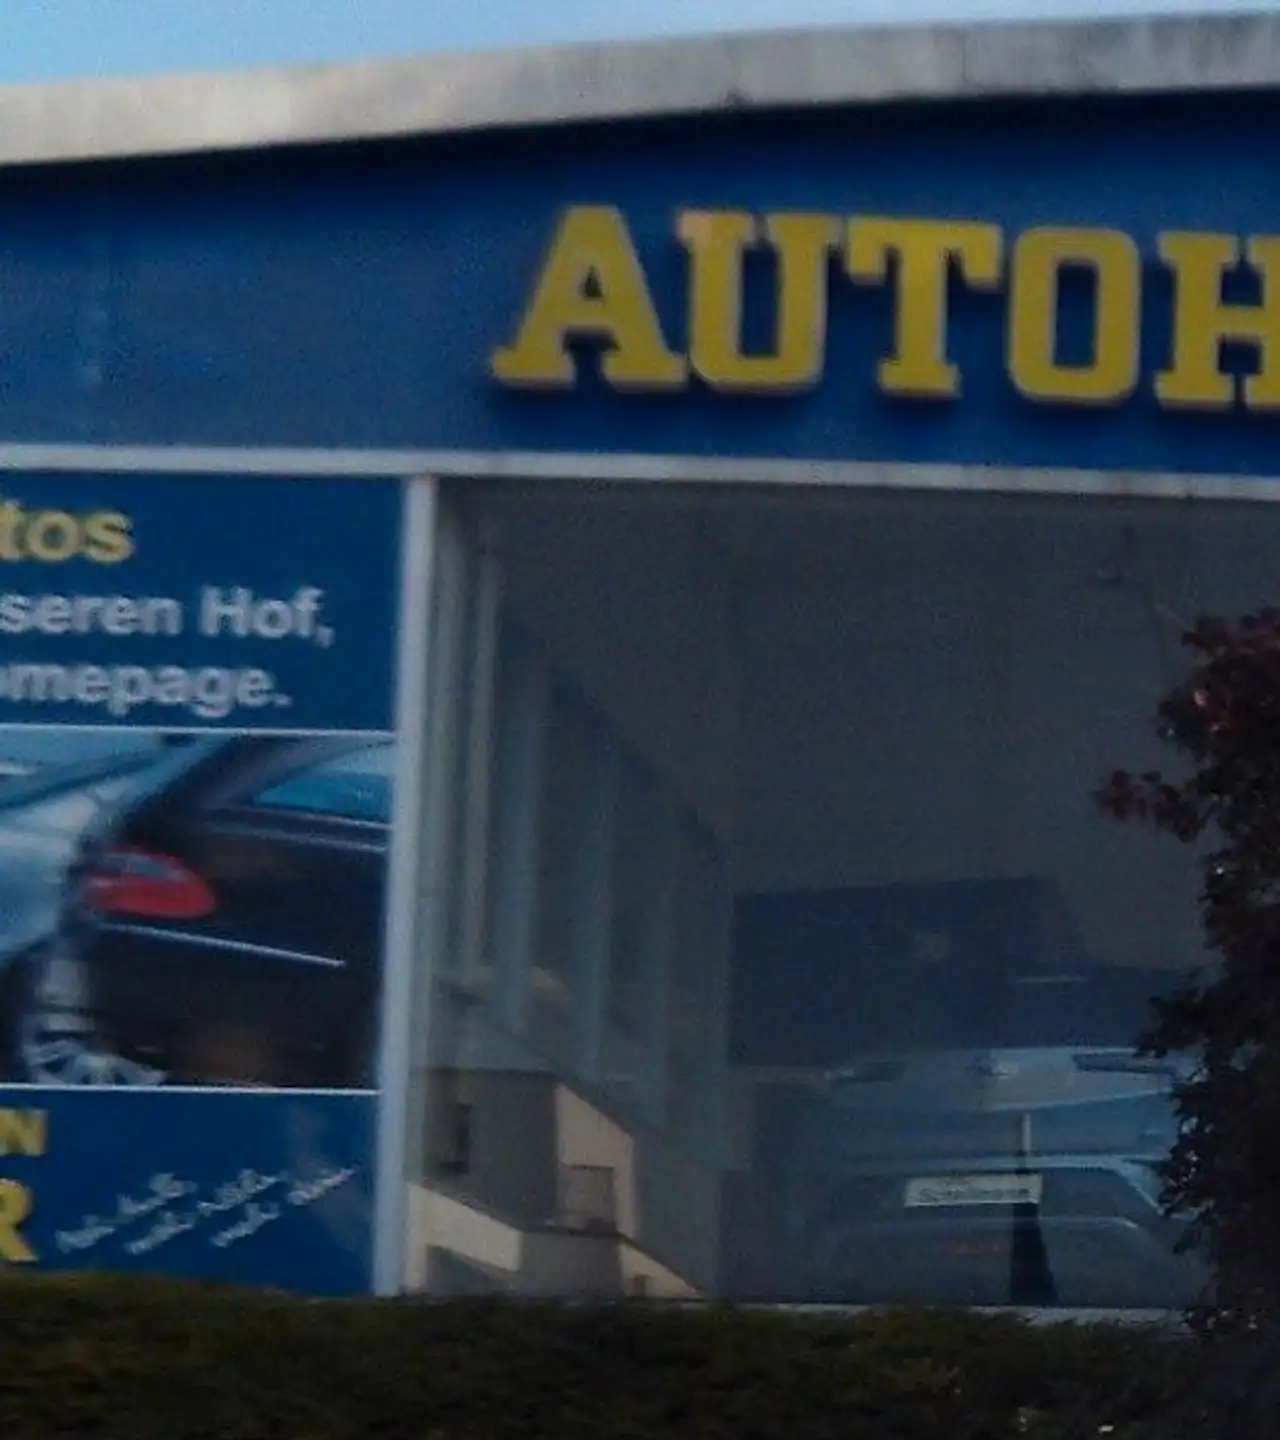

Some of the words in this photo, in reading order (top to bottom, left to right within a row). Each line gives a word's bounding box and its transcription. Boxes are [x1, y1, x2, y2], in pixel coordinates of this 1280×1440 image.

[0, 594, 182, 636] seren
[200, 585, 335, 648] Hof,
[0, 661, 292, 718] mepage.
